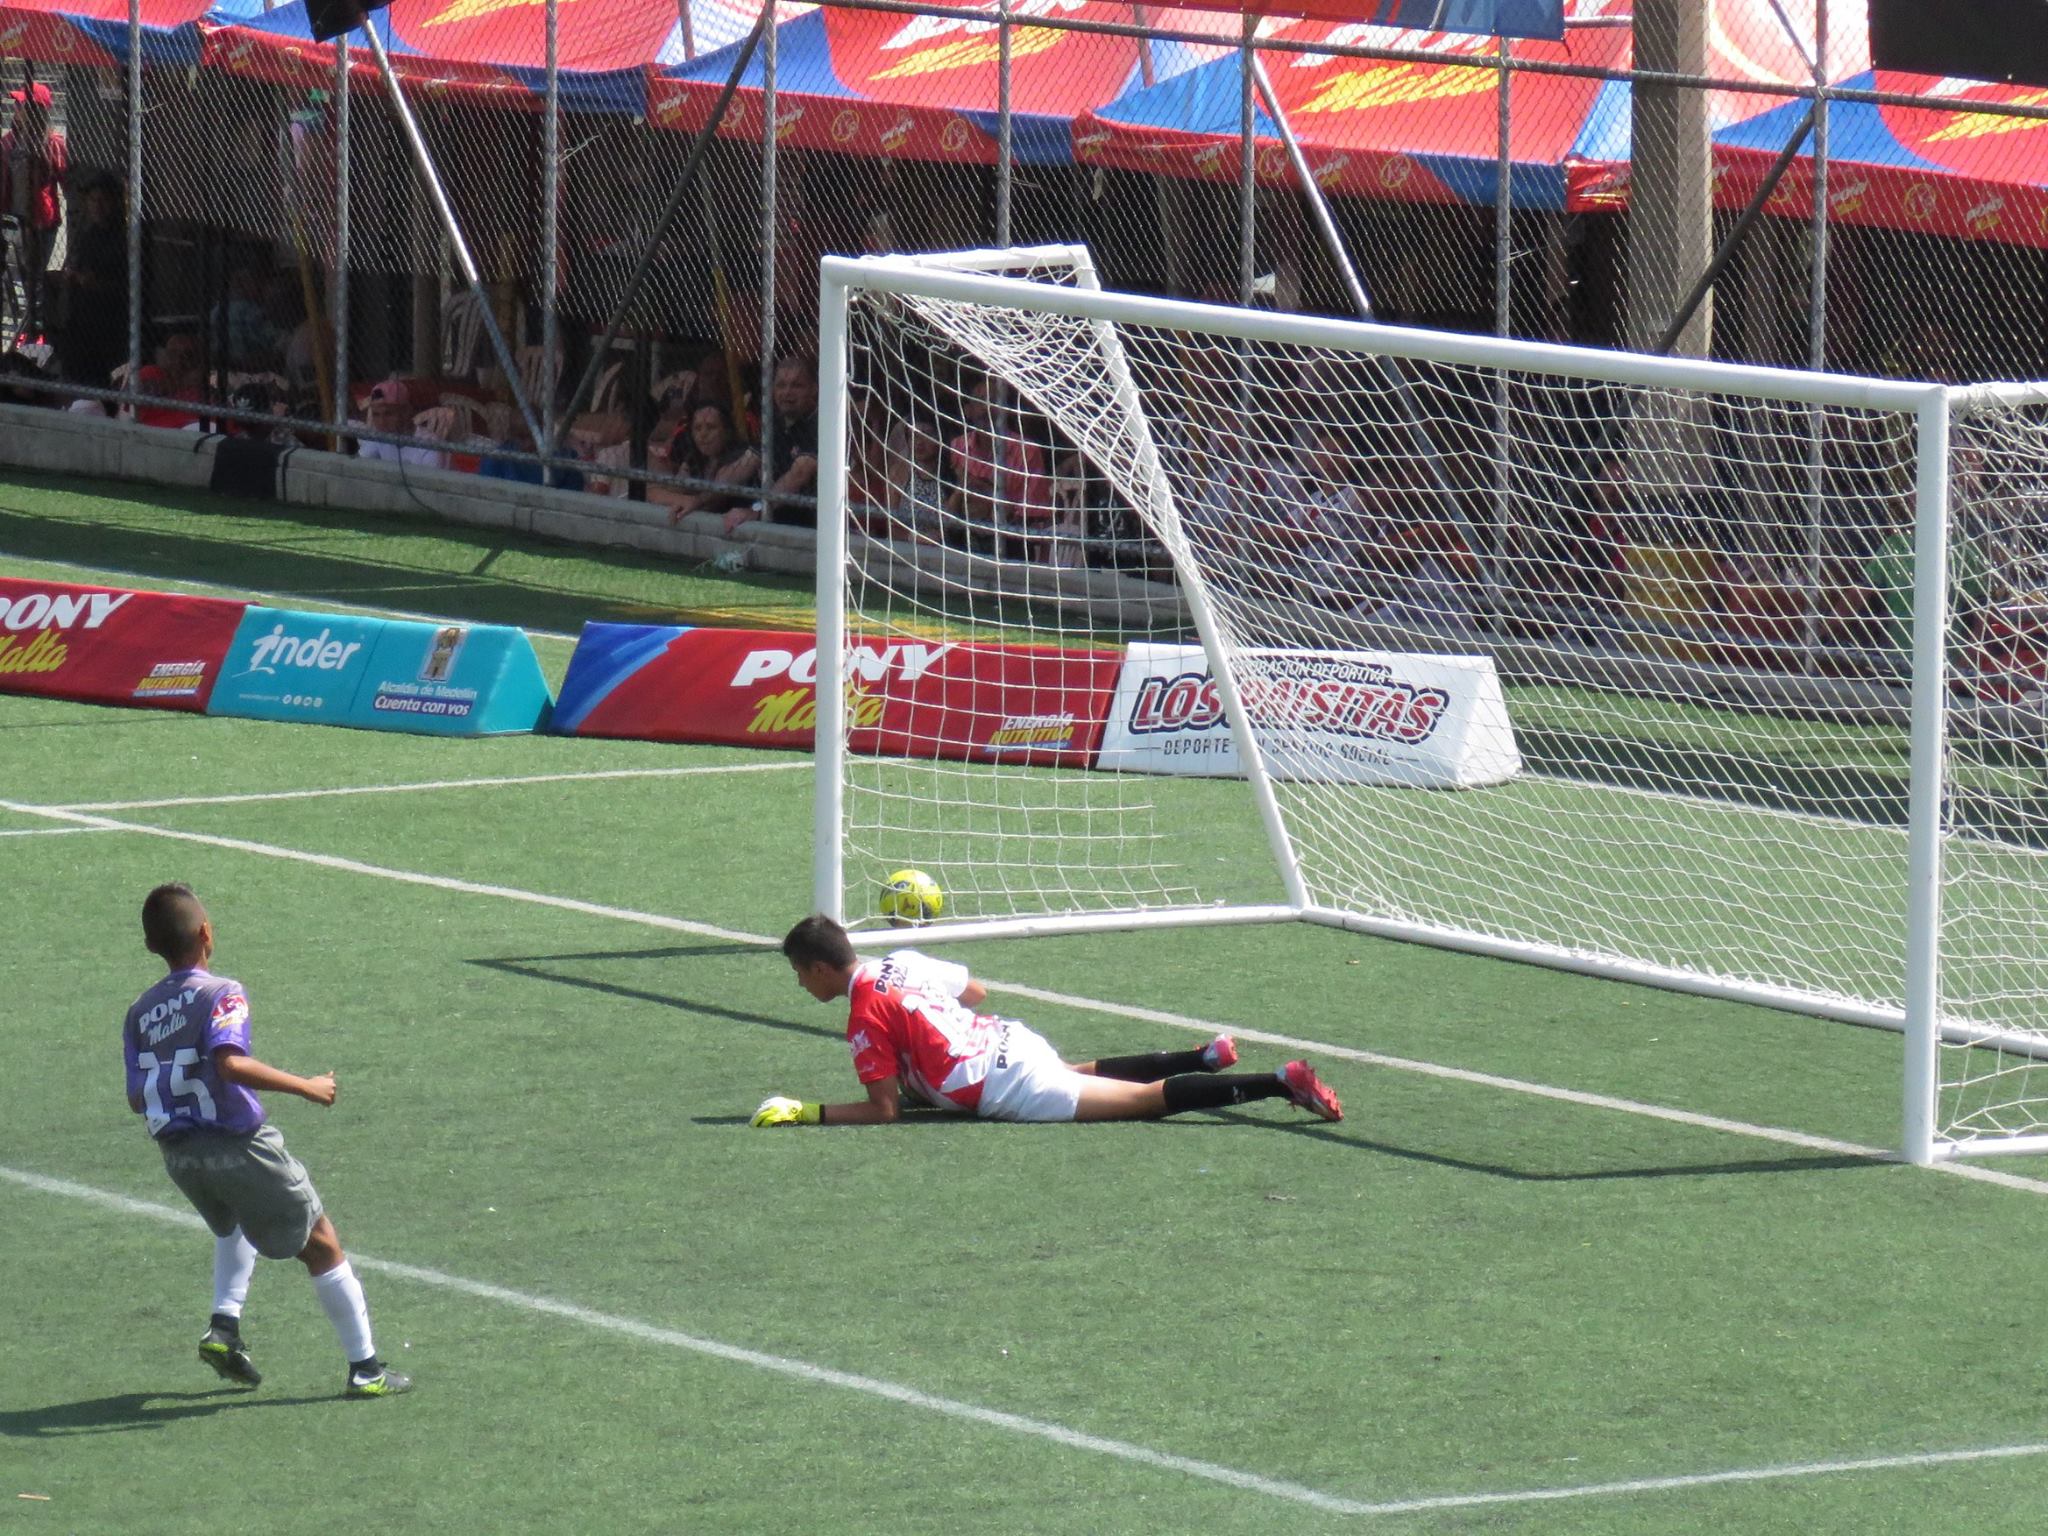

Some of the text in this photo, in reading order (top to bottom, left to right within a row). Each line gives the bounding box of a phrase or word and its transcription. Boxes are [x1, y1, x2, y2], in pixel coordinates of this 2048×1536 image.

[0, 593, 135, 631] ONY
[246, 624, 361, 676] inder
[374, 695, 470, 716] Cuenta con vos
[1132, 677, 1224, 731] LOS
[1164, 737, 1230, 756] DEPORTE
[139, 985, 204, 1034] PONY
[148, 1012, 189, 1046] Malta
[138, 1047, 217, 1137] 15
